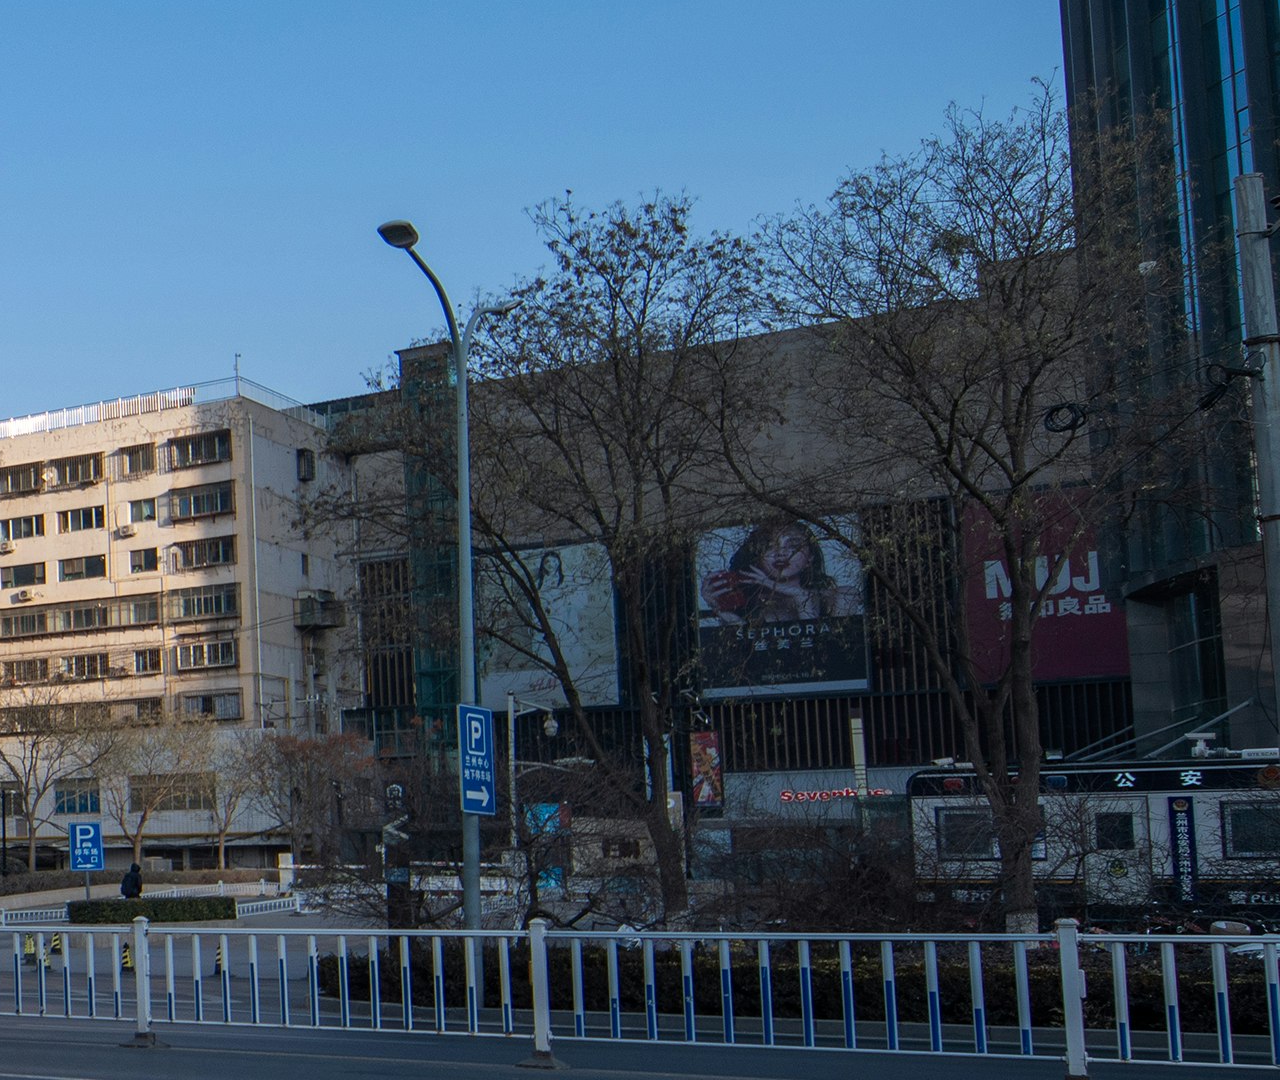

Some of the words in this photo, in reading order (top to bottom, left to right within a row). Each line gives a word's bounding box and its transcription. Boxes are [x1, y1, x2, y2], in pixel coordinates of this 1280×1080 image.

[984, 551, 1100, 600] MUJ
[735, 623, 831, 640] SEPHORA
[471, 720, 482, 749] P
[465, 755, 489, 769] 兰州中心
[464, 769, 491, 782] 地下停车场
[780, 787, 886, 802] Sevenbs
[76, 825, 95, 848] P
